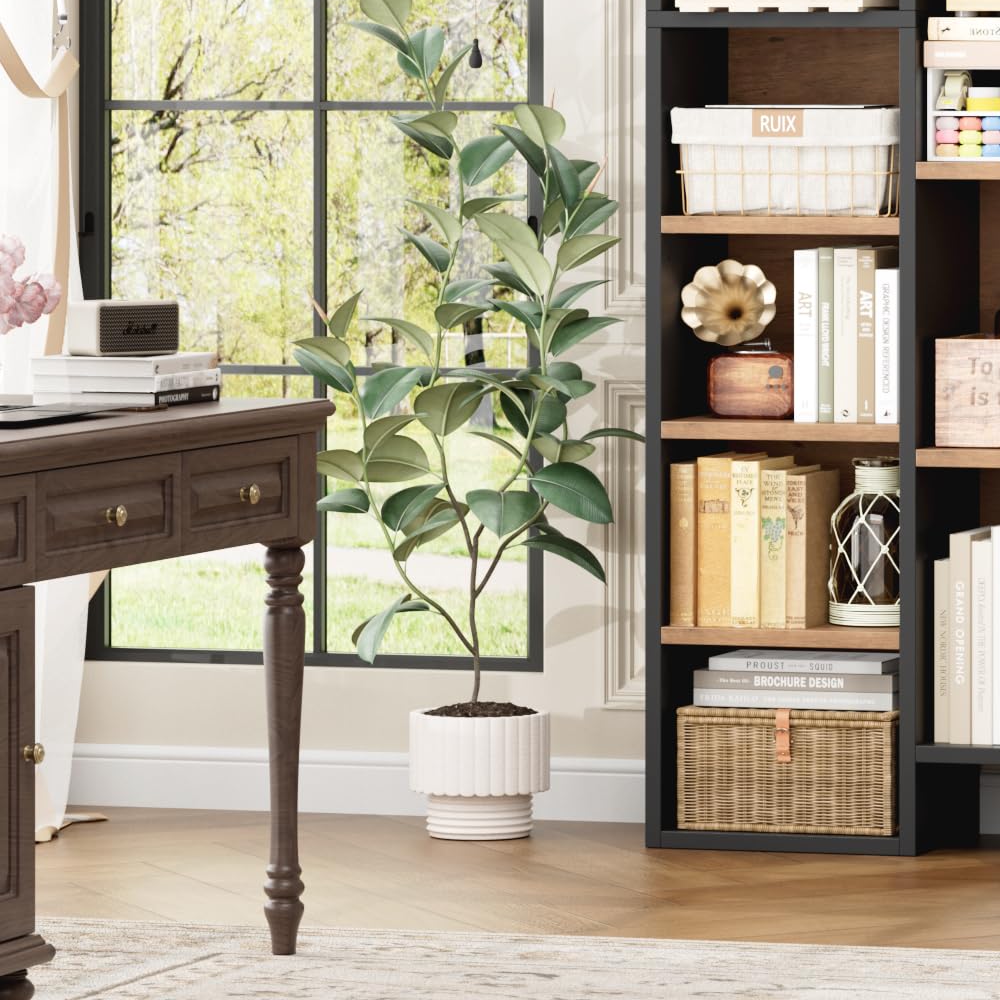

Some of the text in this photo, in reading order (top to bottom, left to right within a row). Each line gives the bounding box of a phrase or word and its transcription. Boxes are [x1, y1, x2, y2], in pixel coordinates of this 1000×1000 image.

[760, 114, 796, 132] RUIX
[798, 291, 812, 318] ART
[860, 290, 873, 318] ART
[882, 318, 890, 344] DESIGN
[968, 356, 992, 375] To
[970, 387, 988, 406] is
[955, 582, 965, 685] GRAND OPENING
[746, 661, 784, 670] PROUST
[754, 676, 806, 688] BROCHURE
[809, 677, 844, 689] DESIGN
